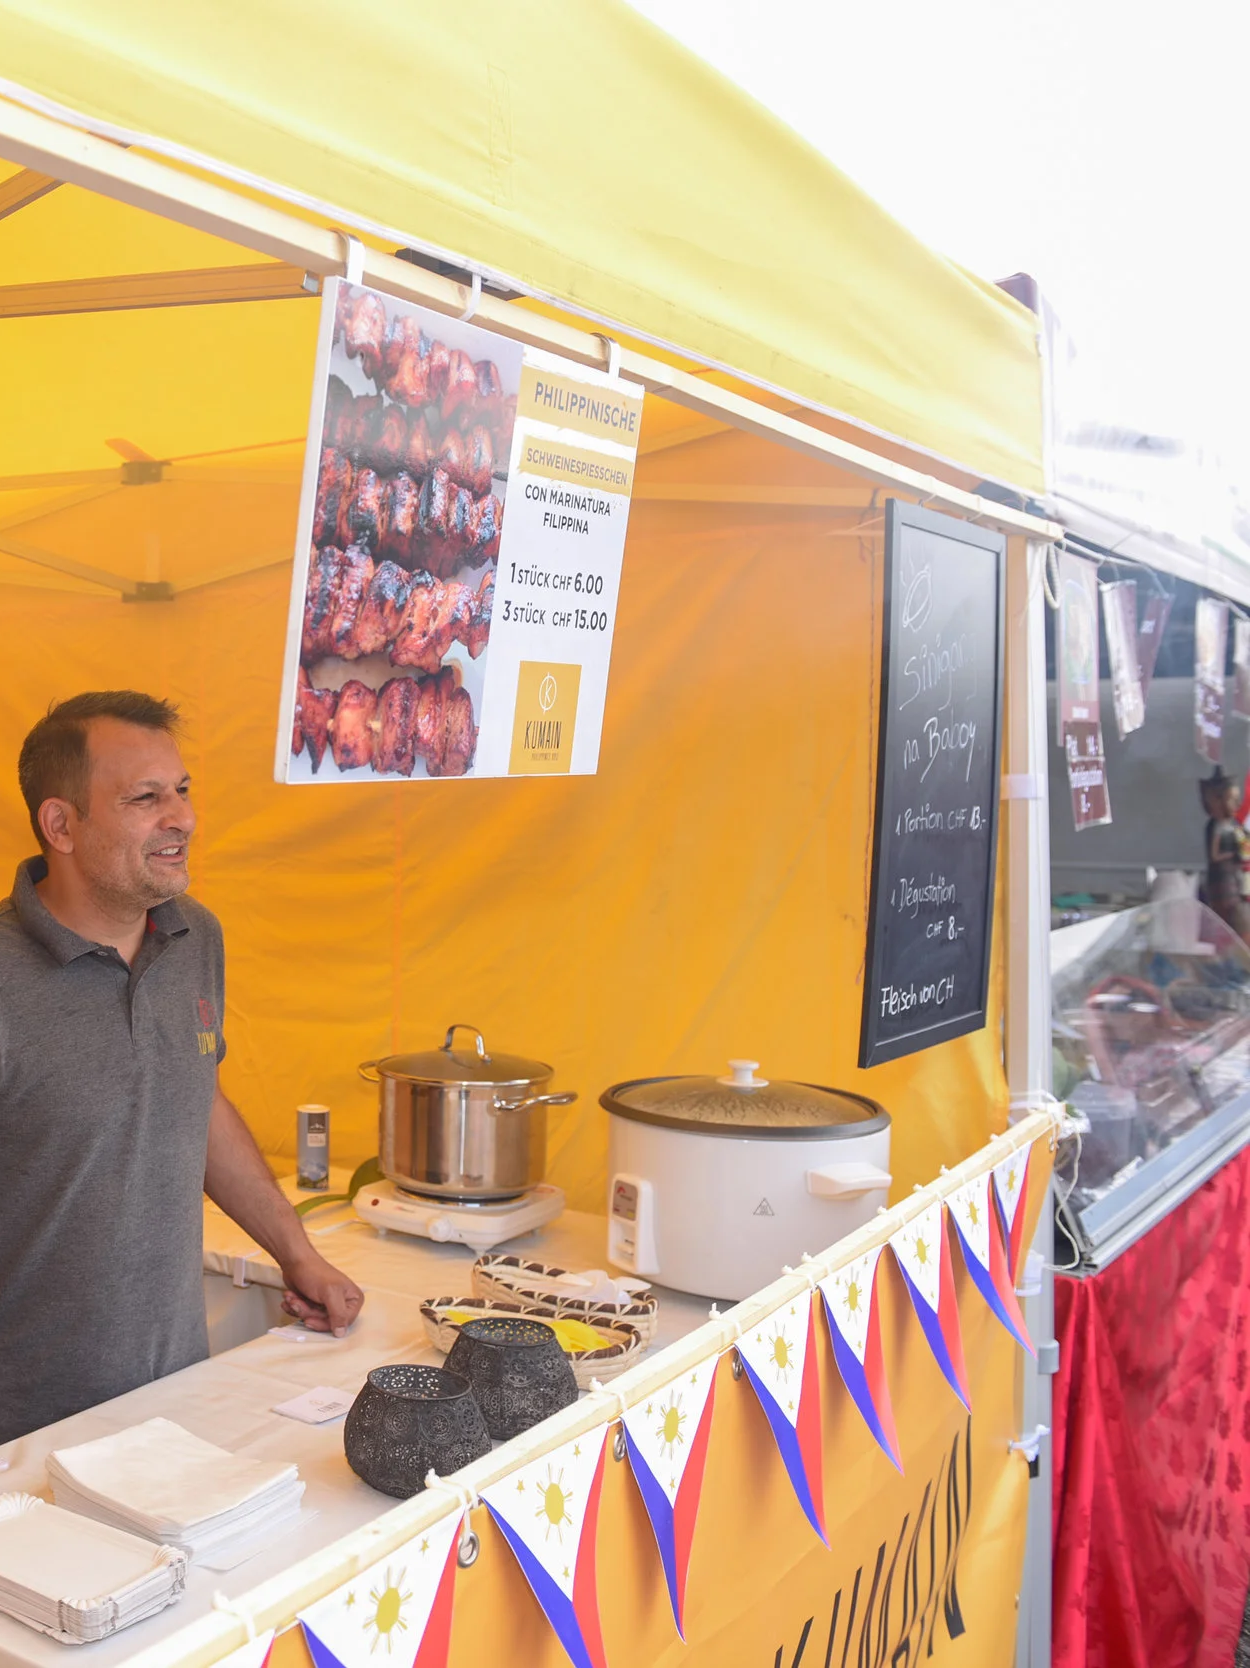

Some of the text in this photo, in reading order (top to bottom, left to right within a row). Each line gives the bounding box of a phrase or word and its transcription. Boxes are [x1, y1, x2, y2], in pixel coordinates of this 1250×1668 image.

[534, 381, 637, 433] PHILIPPINISCHE
[526, 447, 627, 486] SCHWEINESPIESSCHEN
[525, 484, 611, 517] CON MARINATURA
[543, 512, 589, 535] FILIPPINA
[510, 562, 603, 595] 1 STÜCK CHF 6.00
[502, 600, 607, 631] 3 STÜCK CHF 15.00
[524, 720, 562, 749] KUMAIN
[904, 739, 920, 770] na
[895, 814, 901, 836] 1
[904, 803, 944, 834] Portion
[947, 808, 968, 830] CHF
[898, 872, 956, 919] Dégustation
[926, 920, 944, 939] CHF
[881, 983, 917, 1018] Fleisch
[936, 974, 955, 1005] CH
